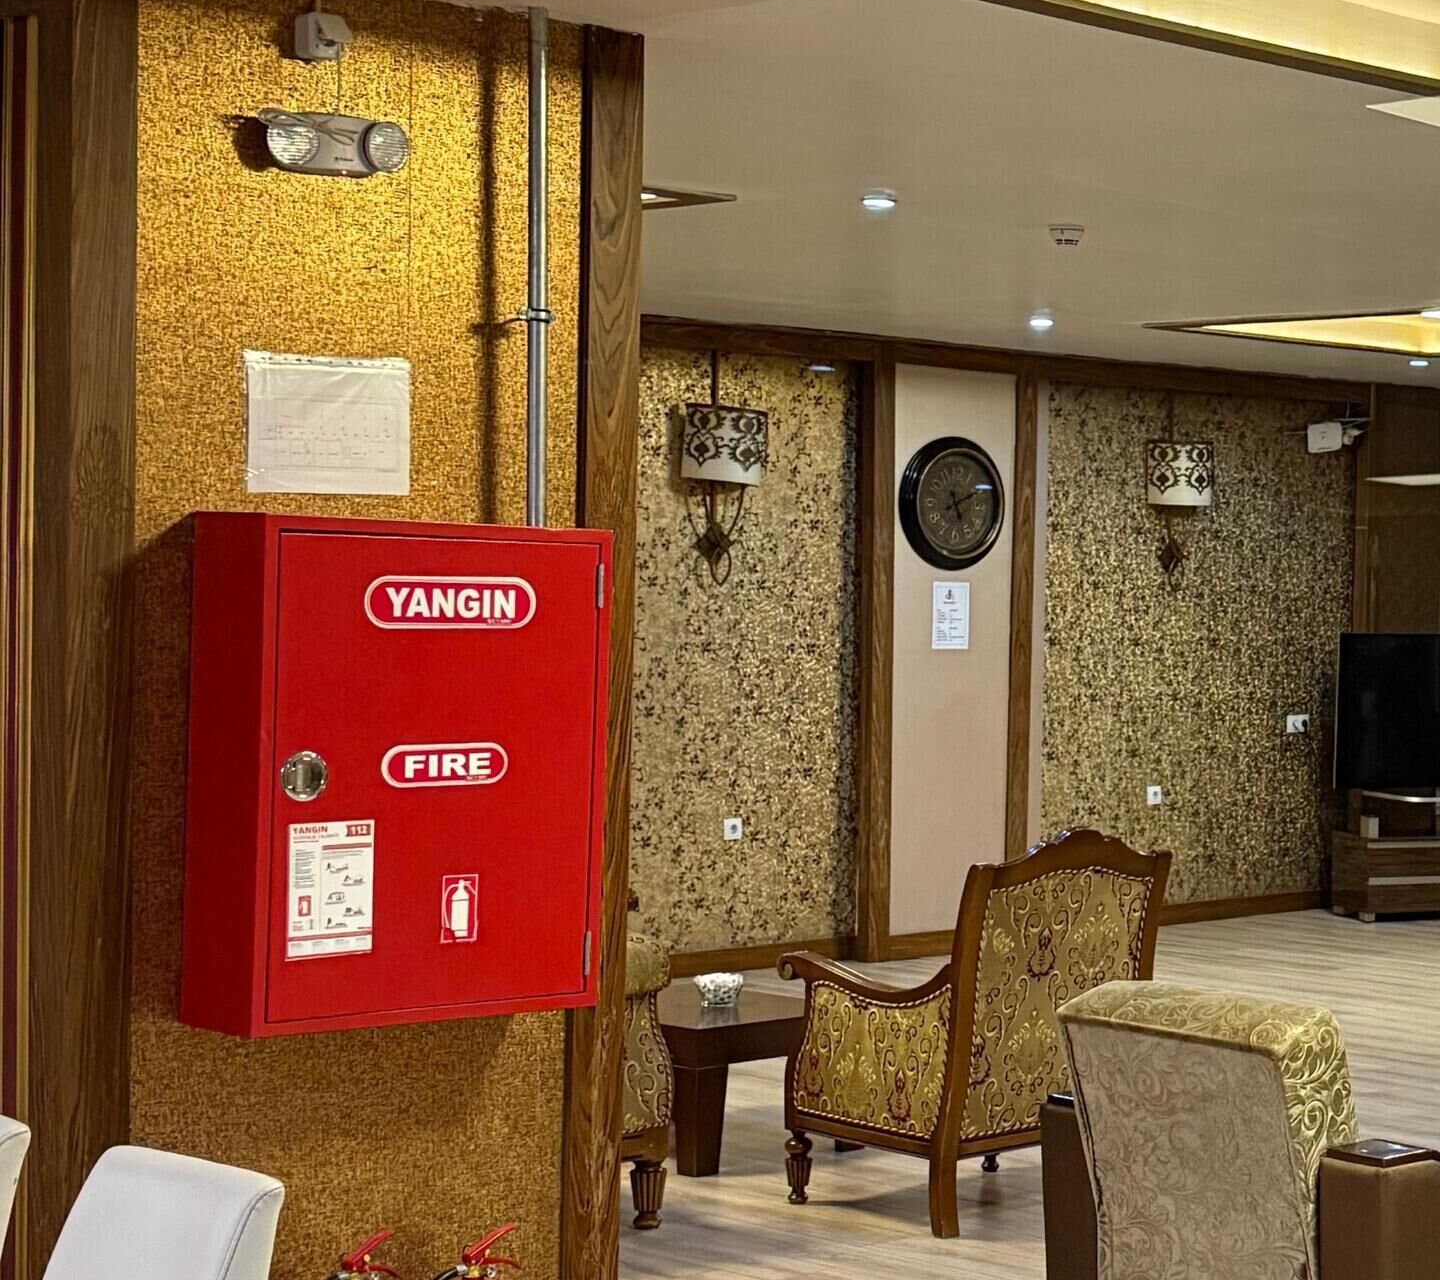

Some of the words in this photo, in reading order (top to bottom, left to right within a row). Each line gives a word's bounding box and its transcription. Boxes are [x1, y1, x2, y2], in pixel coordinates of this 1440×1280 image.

[385, 587, 516, 619] YANGIN
[404, 752, 492, 779] FIRE
[293, 826, 328, 834] YANGIN
[351, 826, 368, 835] 112
